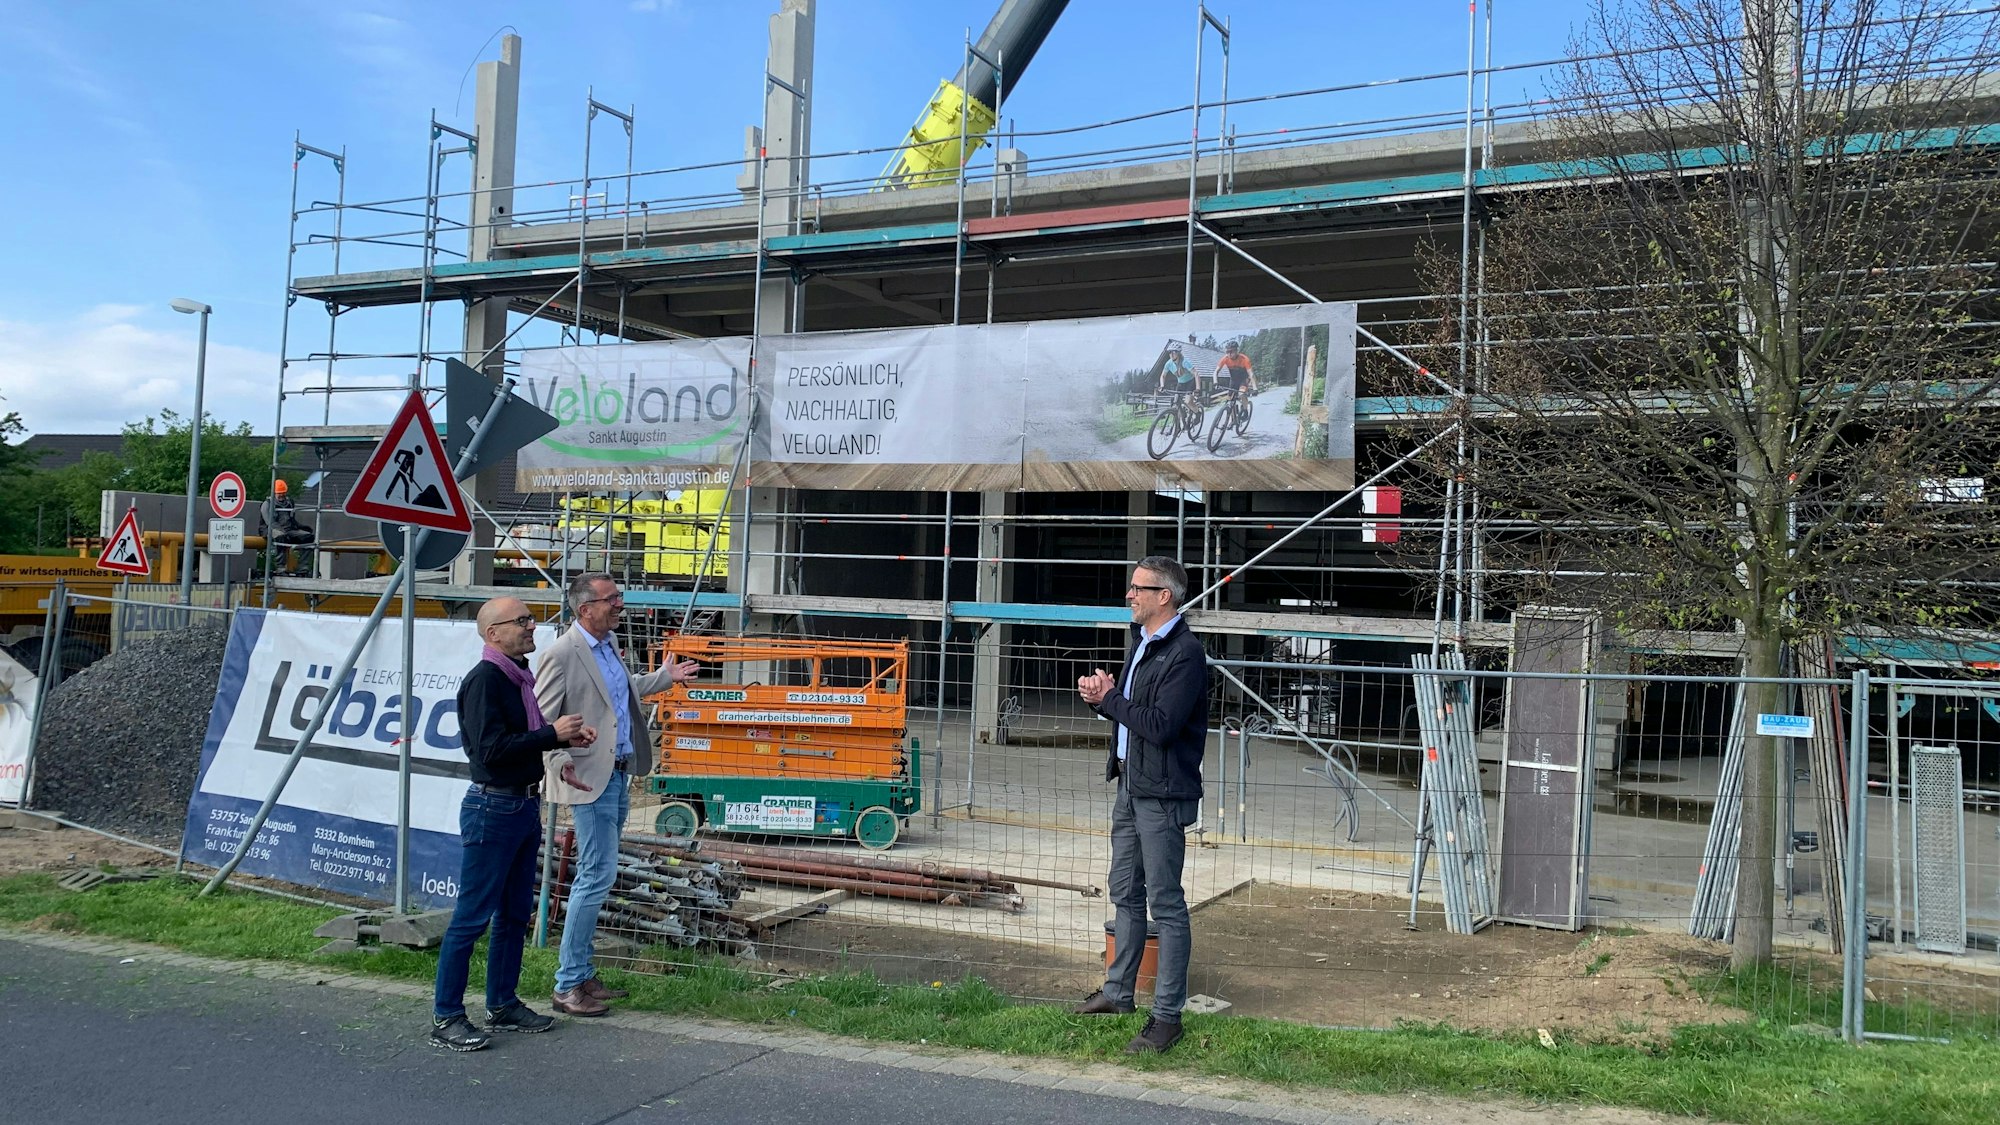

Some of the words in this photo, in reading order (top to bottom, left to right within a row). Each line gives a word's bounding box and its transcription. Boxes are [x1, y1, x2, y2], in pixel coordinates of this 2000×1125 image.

[787, 361, 904, 389] PERSÖNLICH,
[527, 366, 738, 427] Veloland
[785, 398, 898, 423] NACHHALTIG,
[588, 430, 618, 444] Sankt
[619, 429, 667, 446] Augustin
[782, 433, 882, 455] VELOLAND!
[532, 467, 730, 488] www.veloland-sanktaugustin.de
[215, 523, 237, 531] Liefer-
[214, 533, 239, 541] verkehr
[220, 542, 232, 550] frei
[20, 566, 109, 577] wirtschaftliches
[687, 689, 744, 701] CRAMER
[718, 712, 851, 725] cramer-arbeitsbuehnen.de
[727, 803, 760, 814] 7164
[763, 799, 813, 809] CRAMER
[210, 808, 240, 823] 53757
[239, 812, 255, 826] San
[262, 816, 297, 834] Augustin
[254, 831, 267, 844] Str.
[268, 834, 280, 846] 86
[314, 826, 337, 843] 53332
[337, 831, 375, 850] Bornheim
[204, 838, 218, 851] Tel.
[260, 849, 271, 861] 96
[311, 842, 371, 866] Mary-Anderson
[371, 854, 385, 869] Str.
[385, 857, 392, 870] 2
[309, 858, 323, 873] Tel.
[323, 861, 347, 878] 02222
[348, 865, 363, 880] 977
[364, 869, 375, 883] 90
[375, 872, 387, 886] 44
